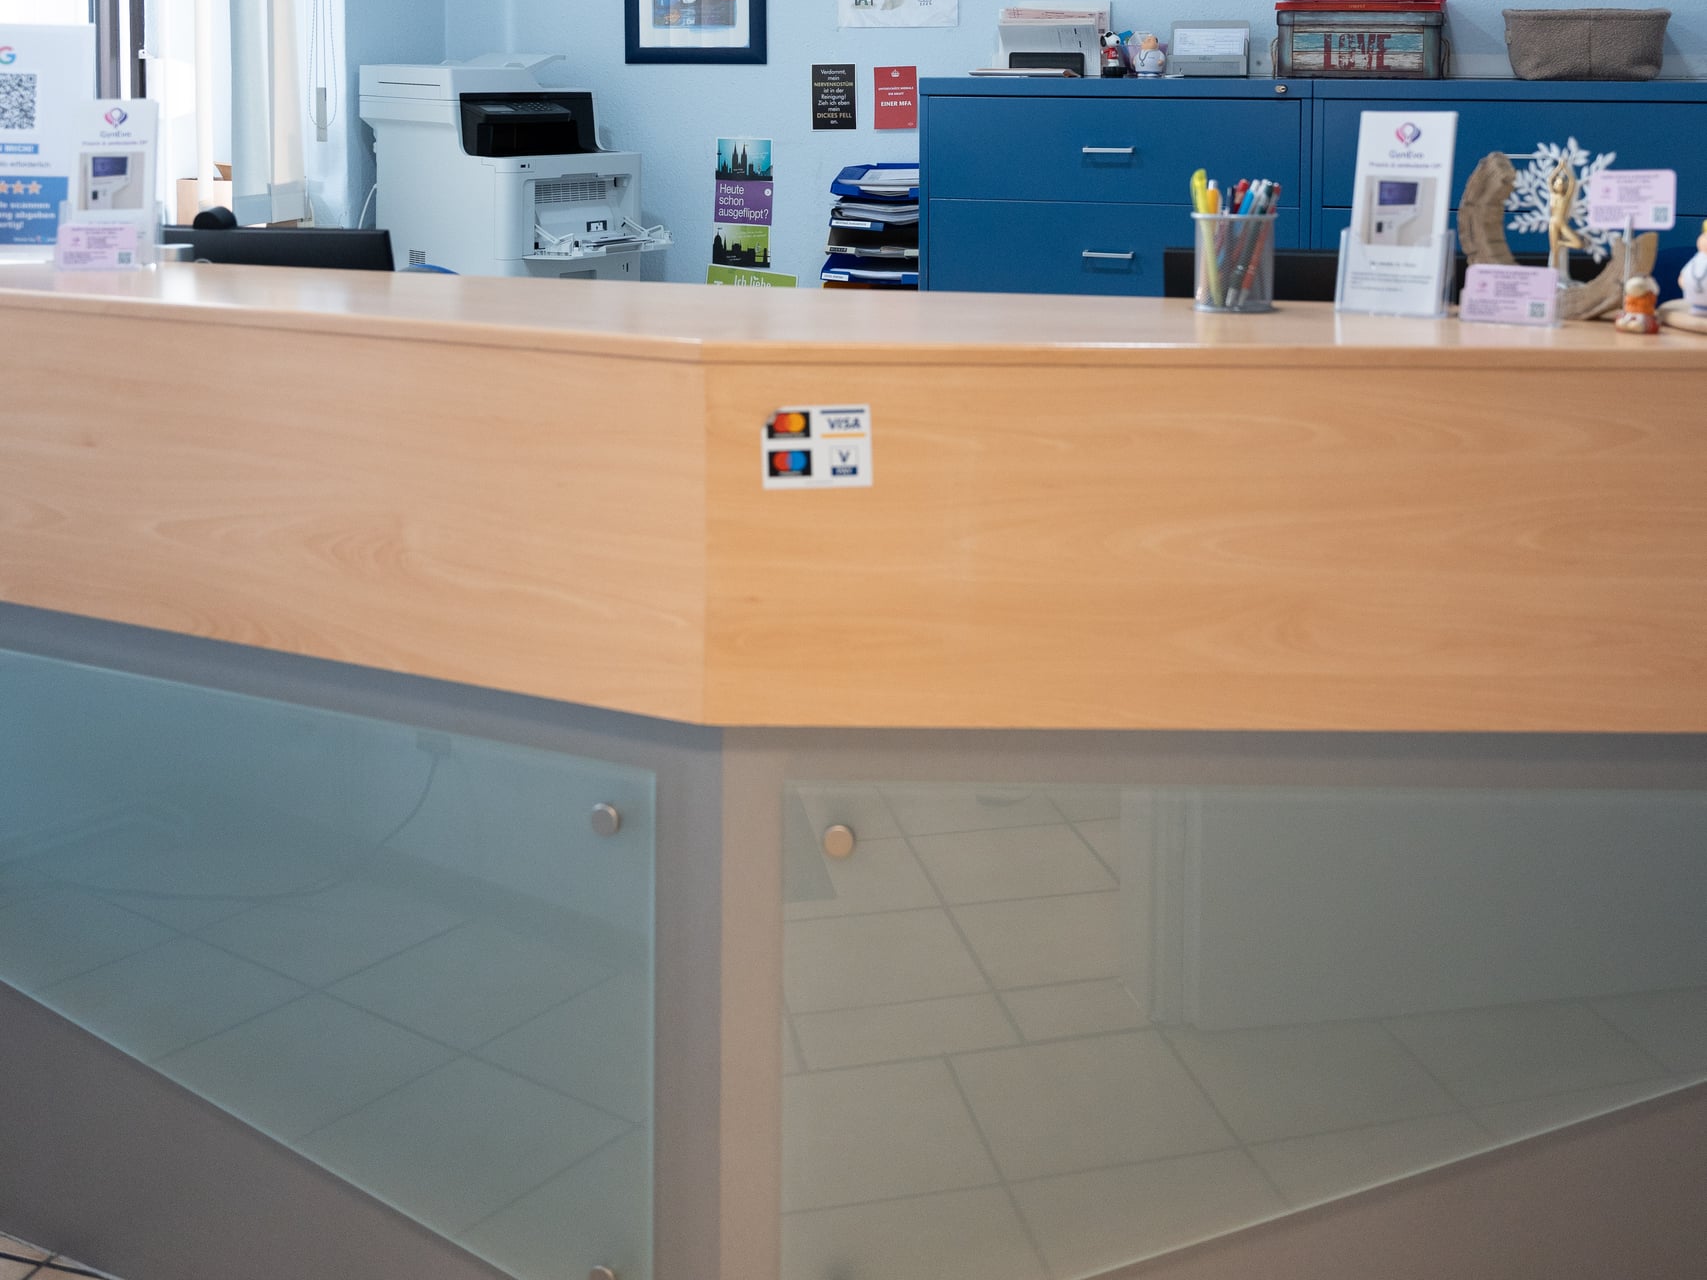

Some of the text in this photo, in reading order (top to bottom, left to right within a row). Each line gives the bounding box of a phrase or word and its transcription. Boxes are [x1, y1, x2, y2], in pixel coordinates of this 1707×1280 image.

[1323, 33, 1392, 70] LOVE
[719, 183, 744, 195] Heute
[718, 195, 744, 206] schon
[718, 207, 769, 221] ausgeflippt?
[827, 417, 861, 429] VISA
